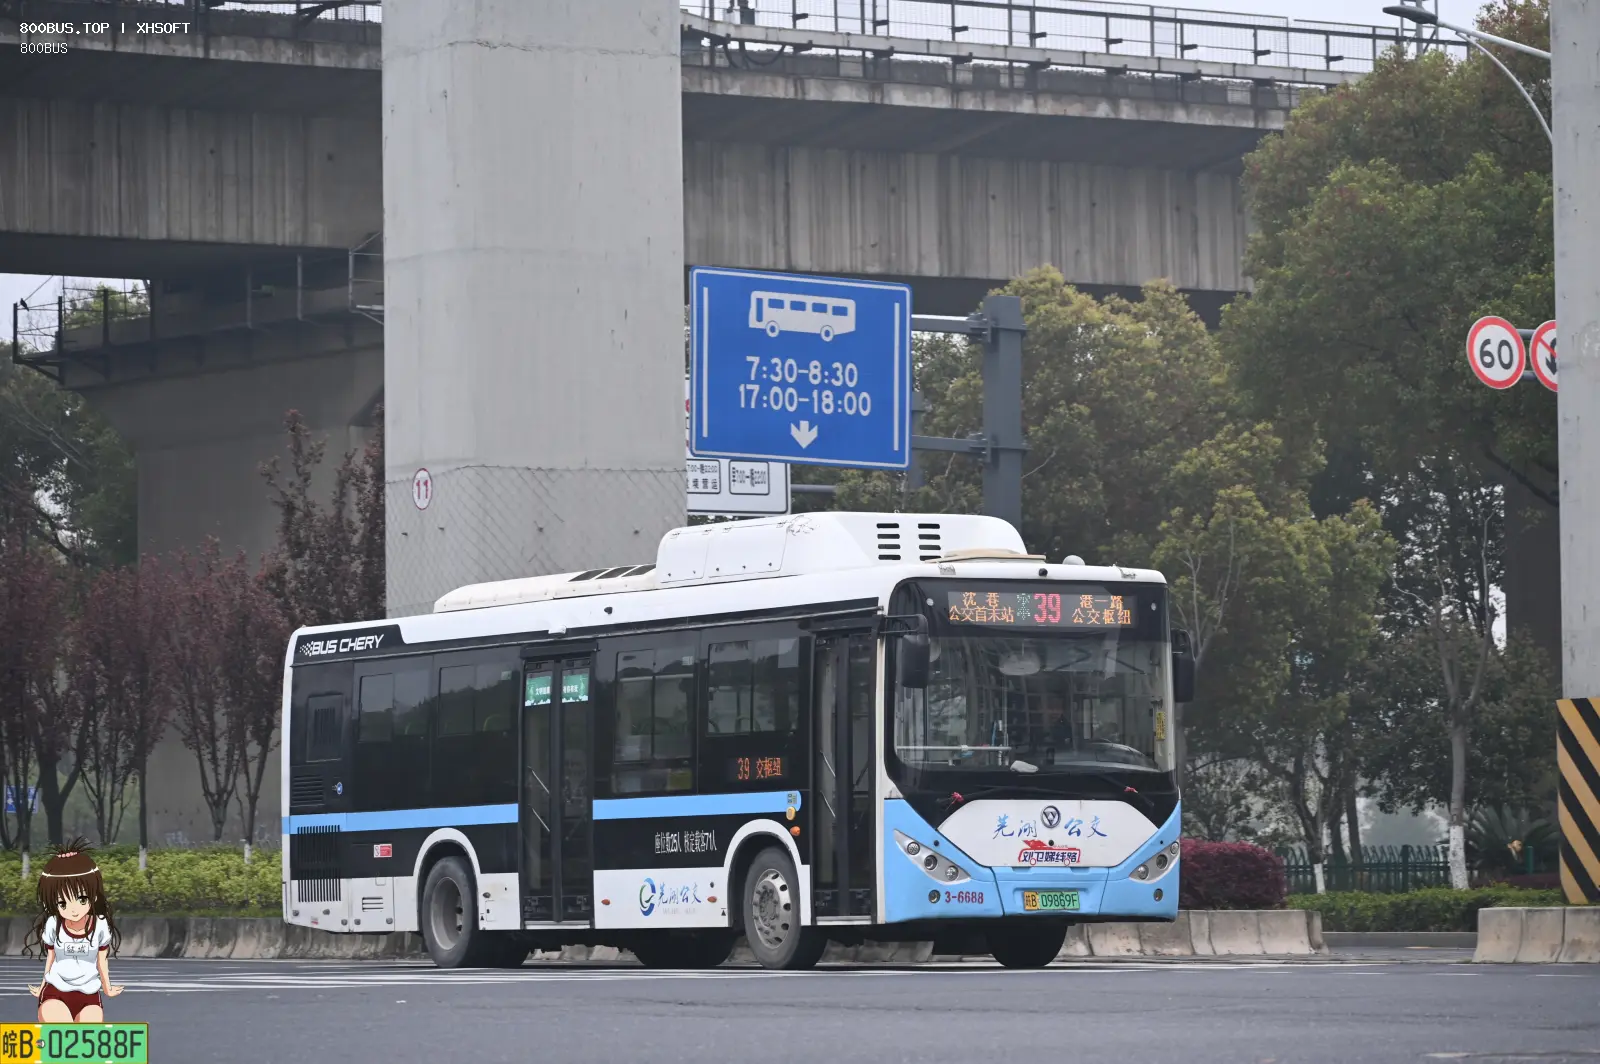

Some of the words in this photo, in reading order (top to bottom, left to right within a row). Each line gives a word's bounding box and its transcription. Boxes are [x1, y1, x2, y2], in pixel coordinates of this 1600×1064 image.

[1479, 338, 1514, 370] 60
[746, 355, 858, 388] 7:30-8:30
[739, 383, 872, 416] 17:00-18:00
[415, 479, 429, 500] 11
[1033, 593, 1062, 623] 39
[1079, 594, 1124, 609] 港一路
[949, 605, 1015, 623] 公交首末站
[1072, 608, 1132, 625] 公交枢纽
[311, 639, 338, 655] BUS
[339, 633, 385, 653] CHERY
[737, 757, 750, 780] 39
[1063, 815, 1108, 838] 公交
[944, 890, 984, 905] 3-6688
[1040, 893, 1079, 908] 09869F
